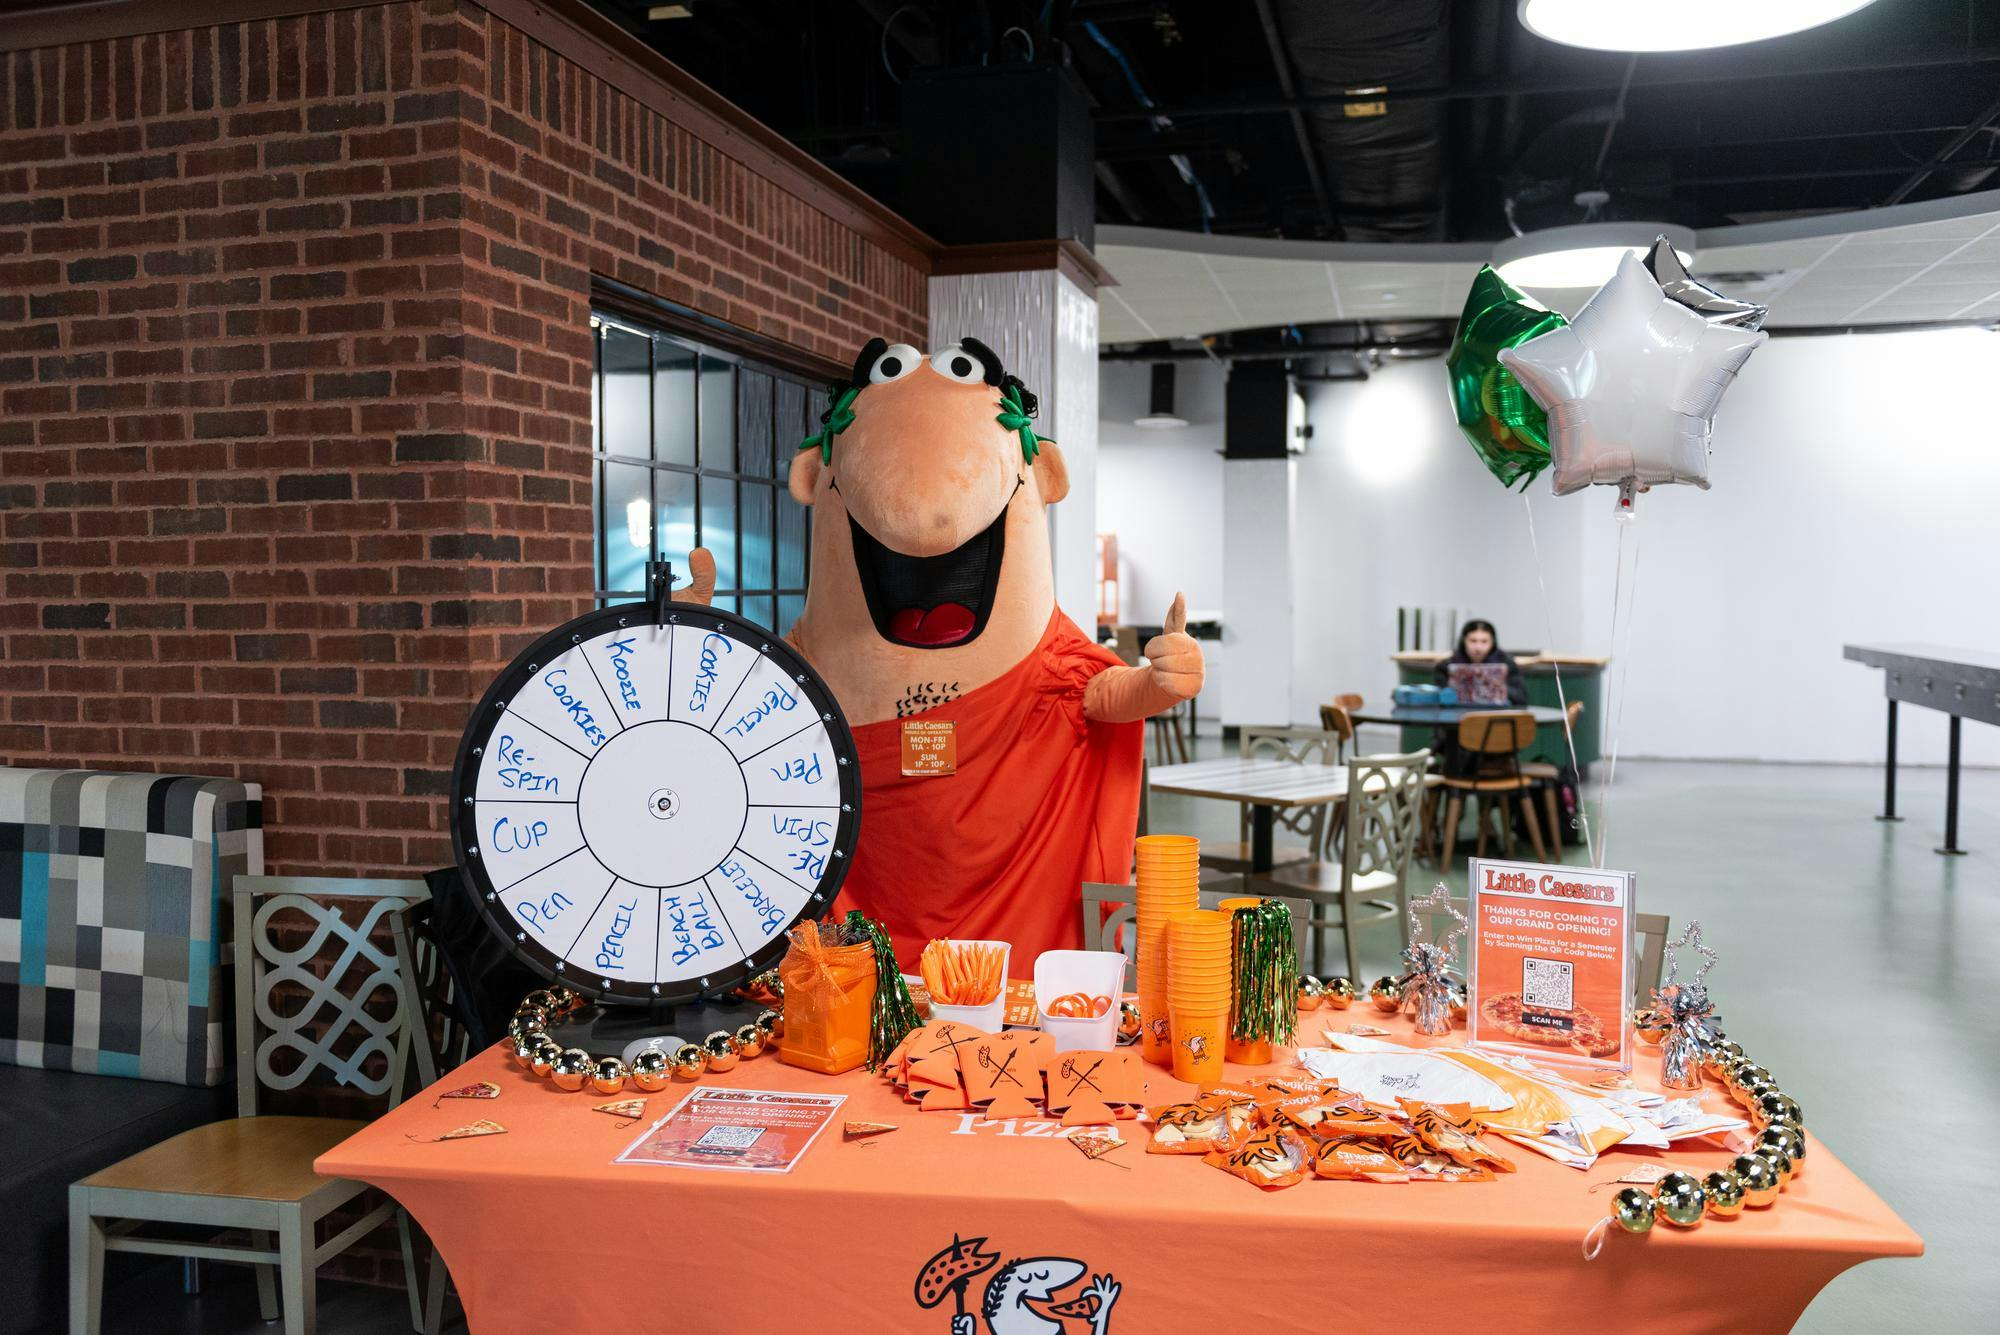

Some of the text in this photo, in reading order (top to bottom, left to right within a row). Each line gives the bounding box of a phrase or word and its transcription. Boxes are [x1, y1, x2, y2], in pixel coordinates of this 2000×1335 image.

[924, 721, 953, 729] Caesars
[920, 753, 938, 761] SUN
[493, 816, 548, 853] CUP
[1485, 870, 1615, 902] Little Caesars
[688, 891, 725, 950] BALL
[1483, 904, 1618, 927] THANKS FOR COMING TO
[1489, 915, 1611, 937] OUR GRAND OPENING!
[1483, 931, 1505, 940] Enter
[1506, 933, 1515, 941] to
[1516, 935, 1533, 943] Win
[1535, 937, 1556, 946] Pizza
[1557, 939, 1569, 947] for
[1577, 942, 1616, 953] Semester
[1484, 938, 1494, 946] by
[1496, 940, 1533, 951] Scanning
[1535, 944, 1548, 952] the
[1549, 945, 1562, 954] QR
[1564, 948, 1585, 956] Code
[1532, 1016, 1563, 1027] SCAN ME
[691, 1103, 736, 1111] HANKS
